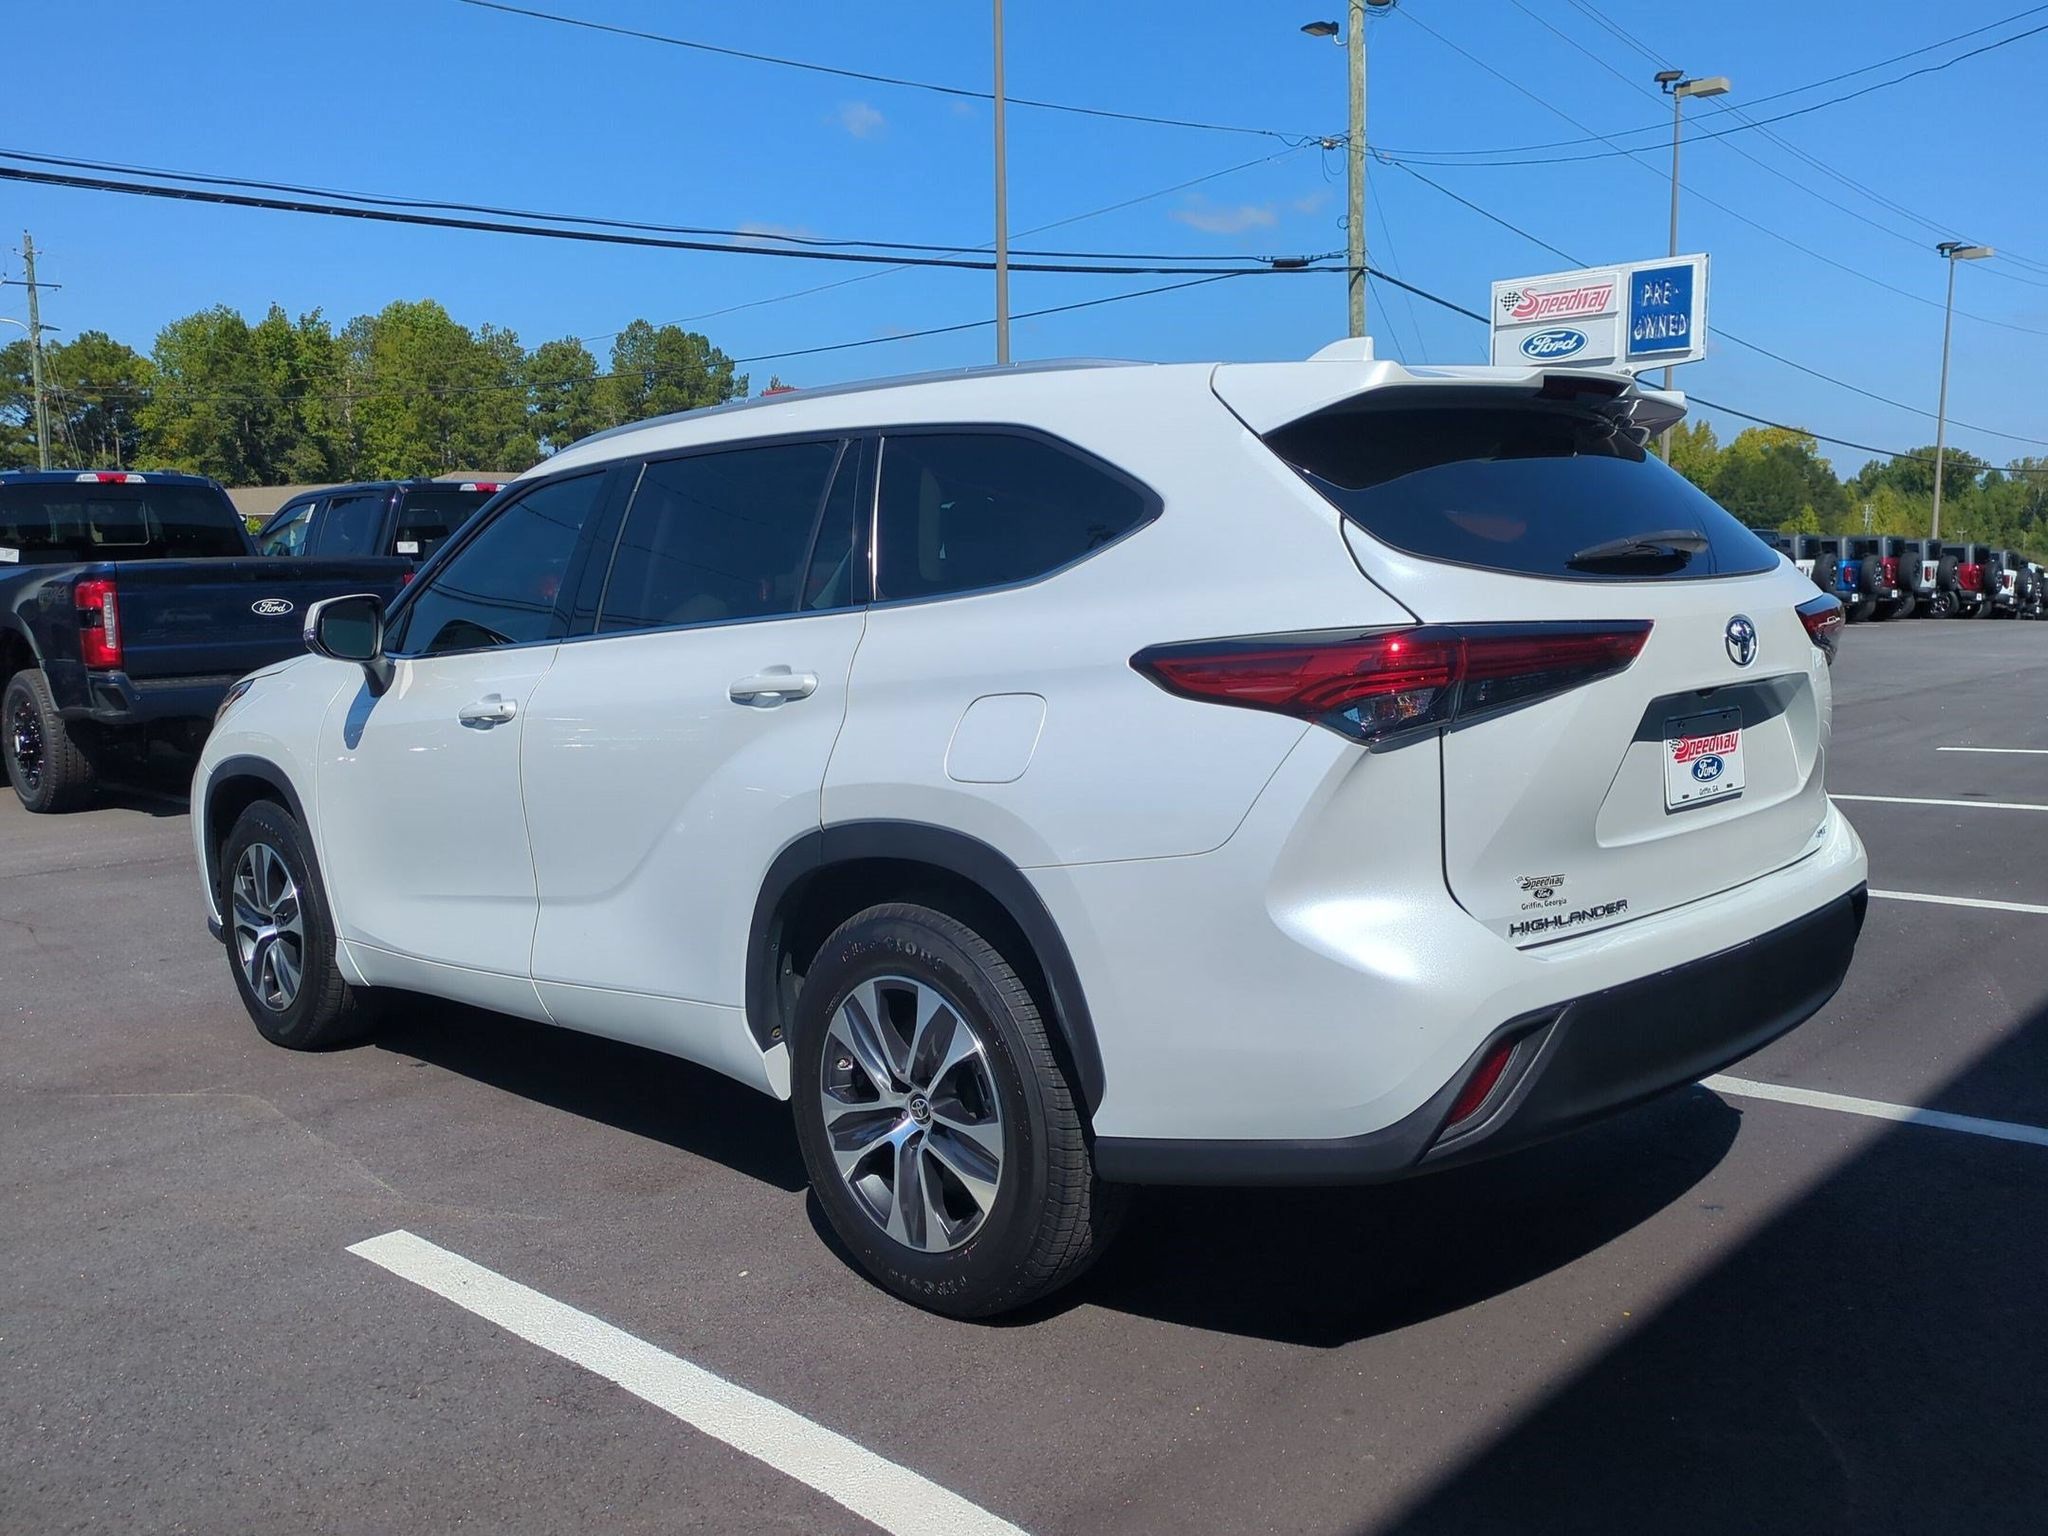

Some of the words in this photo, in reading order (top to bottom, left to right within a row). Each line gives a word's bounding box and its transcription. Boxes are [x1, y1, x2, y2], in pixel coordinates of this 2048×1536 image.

[1510, 287, 1612, 319] Speedway
[1528, 332, 1578, 355] Ford
[259, 601, 286, 613] Ford
[1674, 735, 1739, 759] Speedway
[1697, 758, 1719, 778] Ford
[1520, 875, 1566, 890] Speedway
[1544, 898, 1567, 907] Georgia
[1509, 899, 1629, 937] HIGHLANDER
